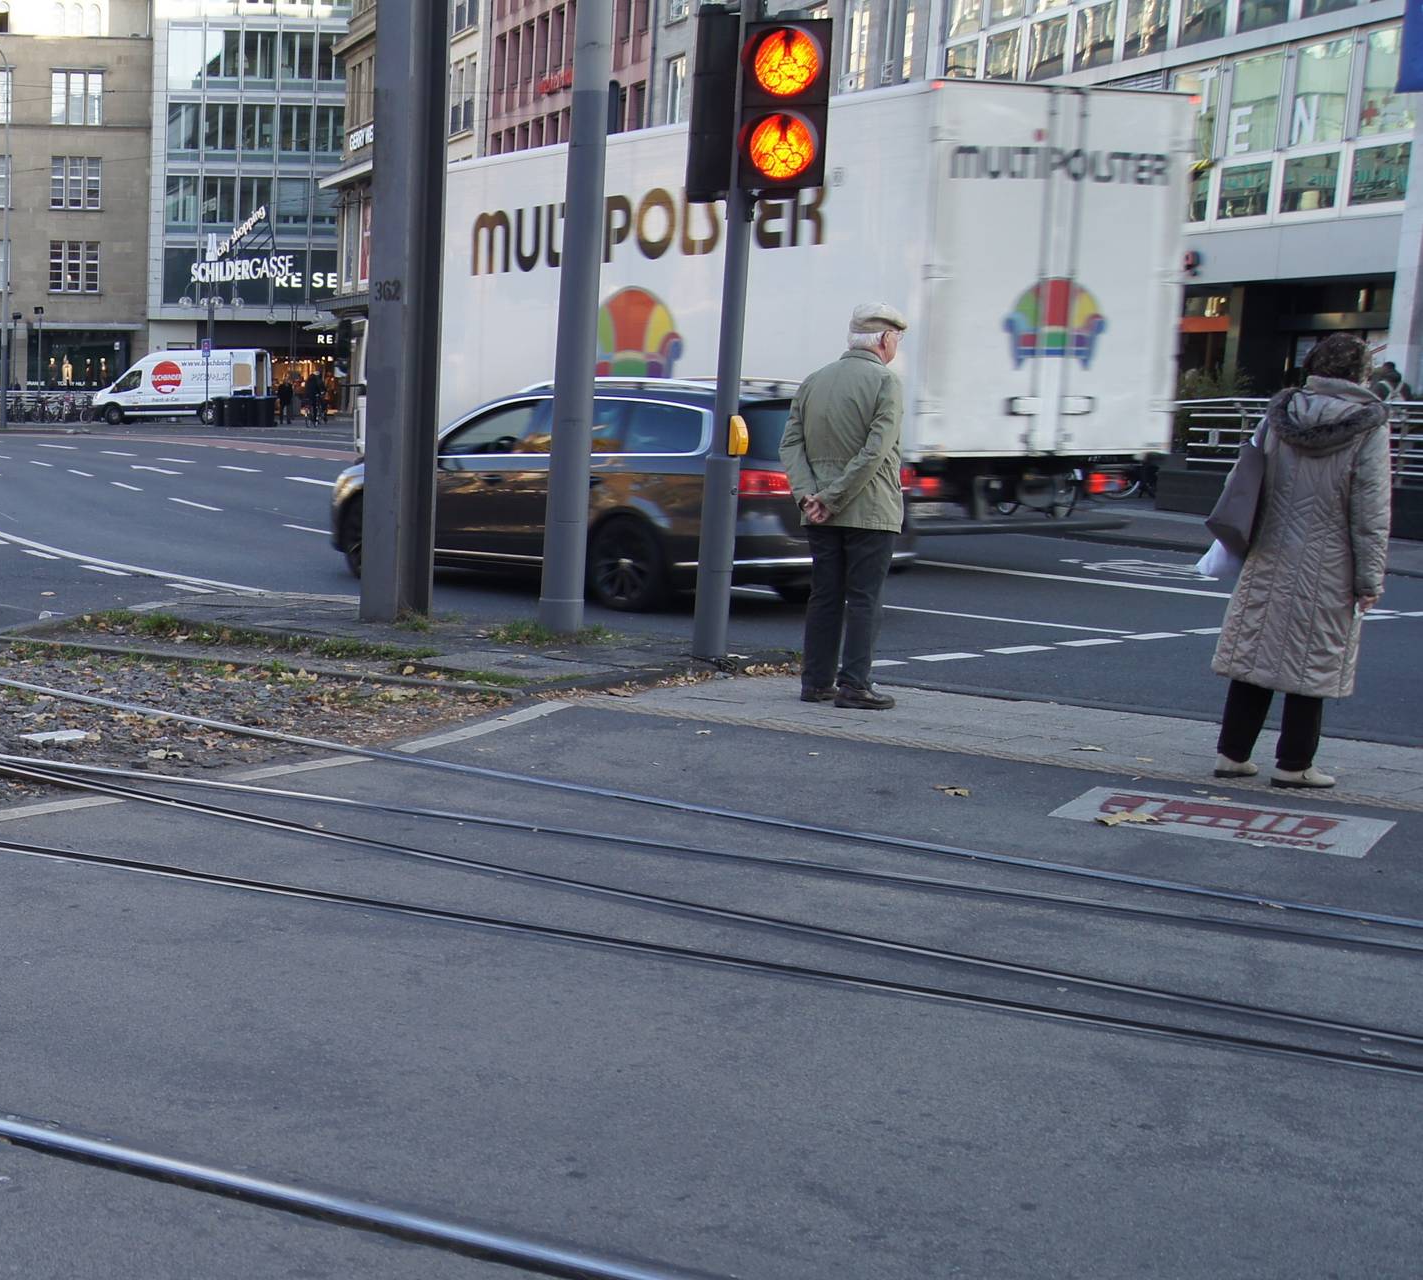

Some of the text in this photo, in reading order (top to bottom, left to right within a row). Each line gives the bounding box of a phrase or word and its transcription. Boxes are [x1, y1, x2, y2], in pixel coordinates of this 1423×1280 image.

[217, 205, 267, 257] city shopping
[472, 187, 827, 276] MULPOLSER
[191, 254, 294, 283] SCHILDERGASSE
[374, 280, 401, 301] 362
